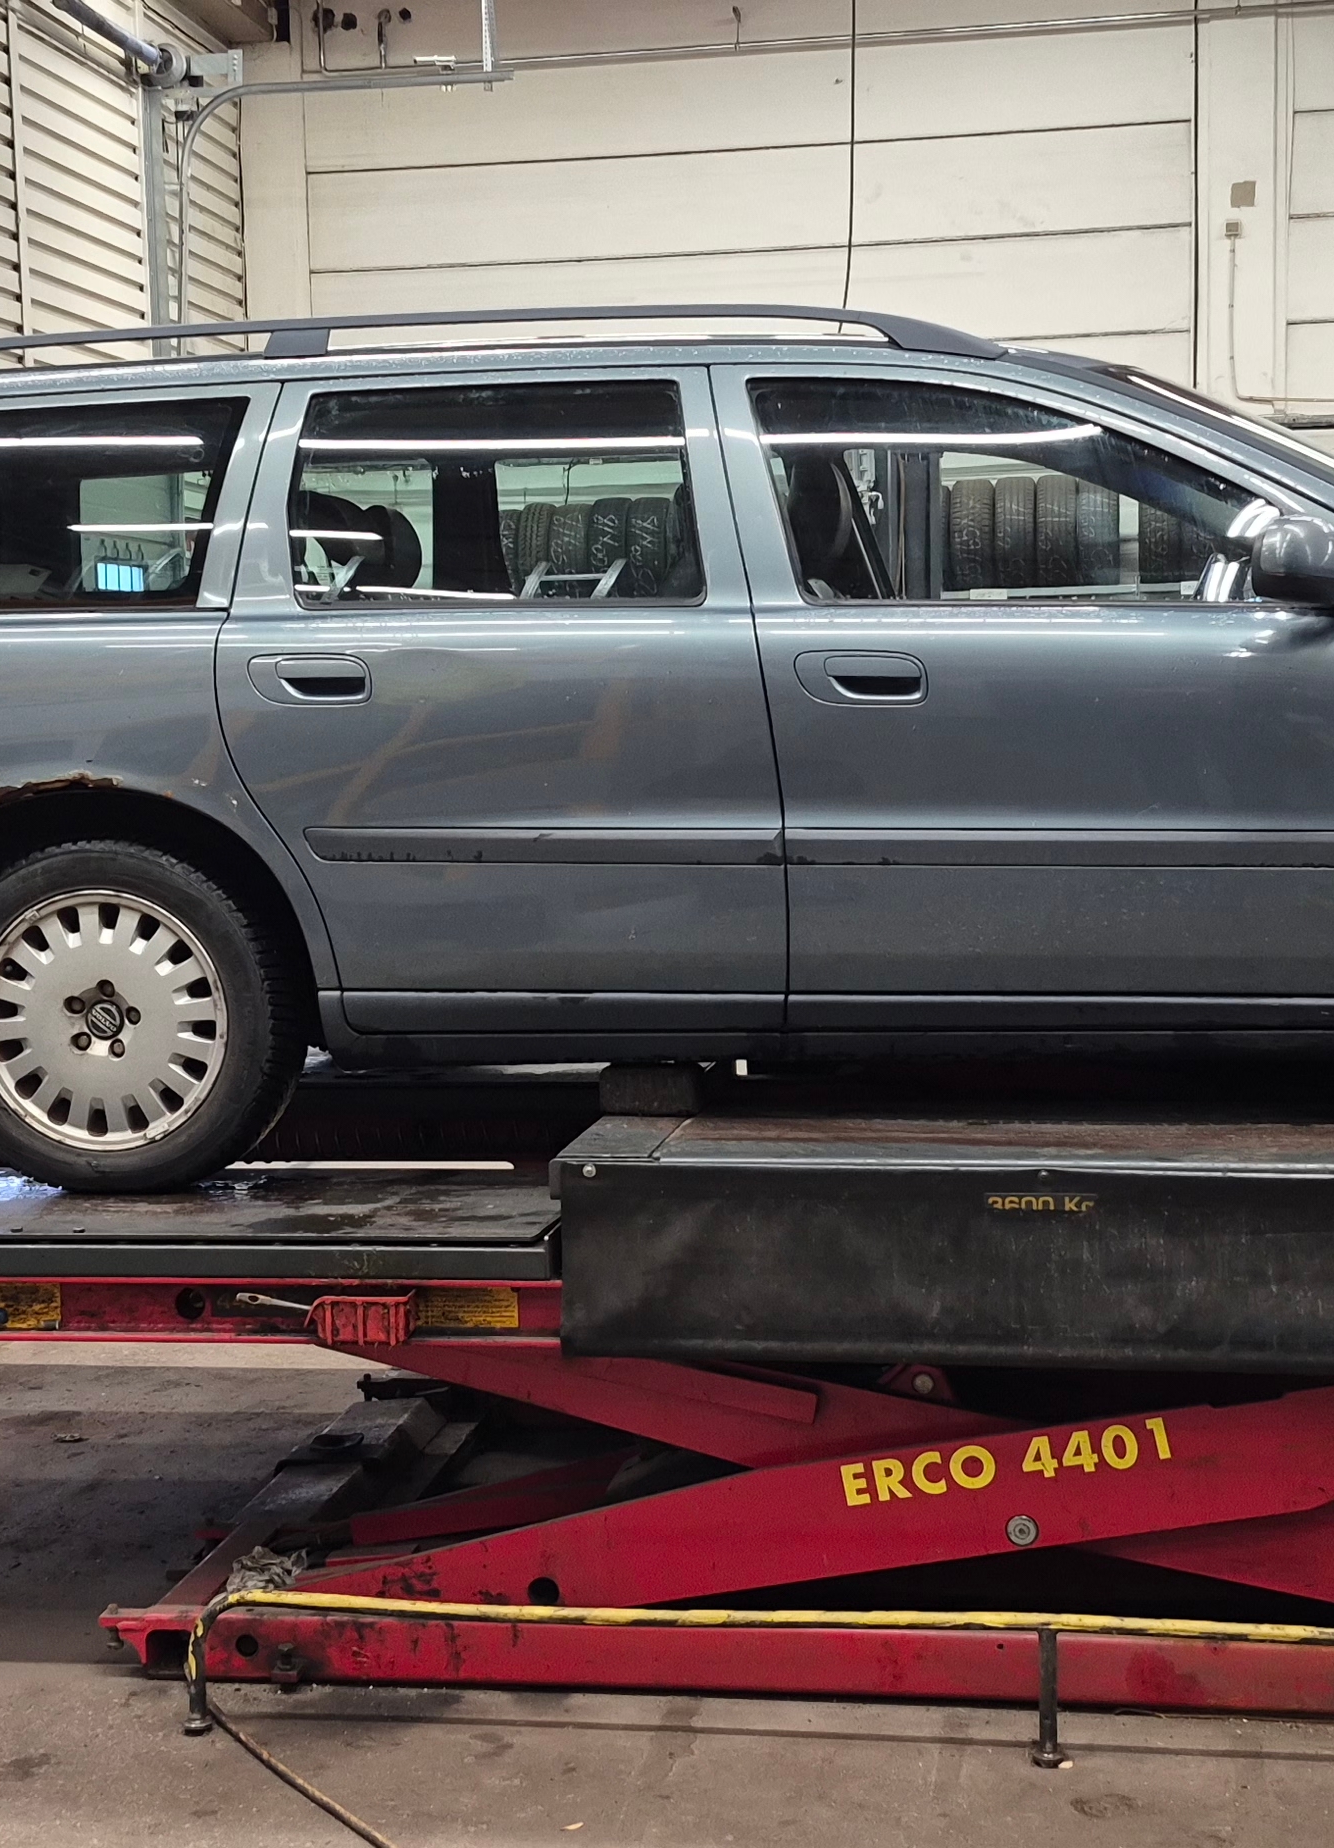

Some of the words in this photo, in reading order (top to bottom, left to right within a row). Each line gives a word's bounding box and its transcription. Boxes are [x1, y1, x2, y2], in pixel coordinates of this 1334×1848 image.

[91, 1008, 118, 1032] VOLVO
[840, 1444, 997, 1507] ERCO
[1020, 1416, 1172, 1479] 4401
